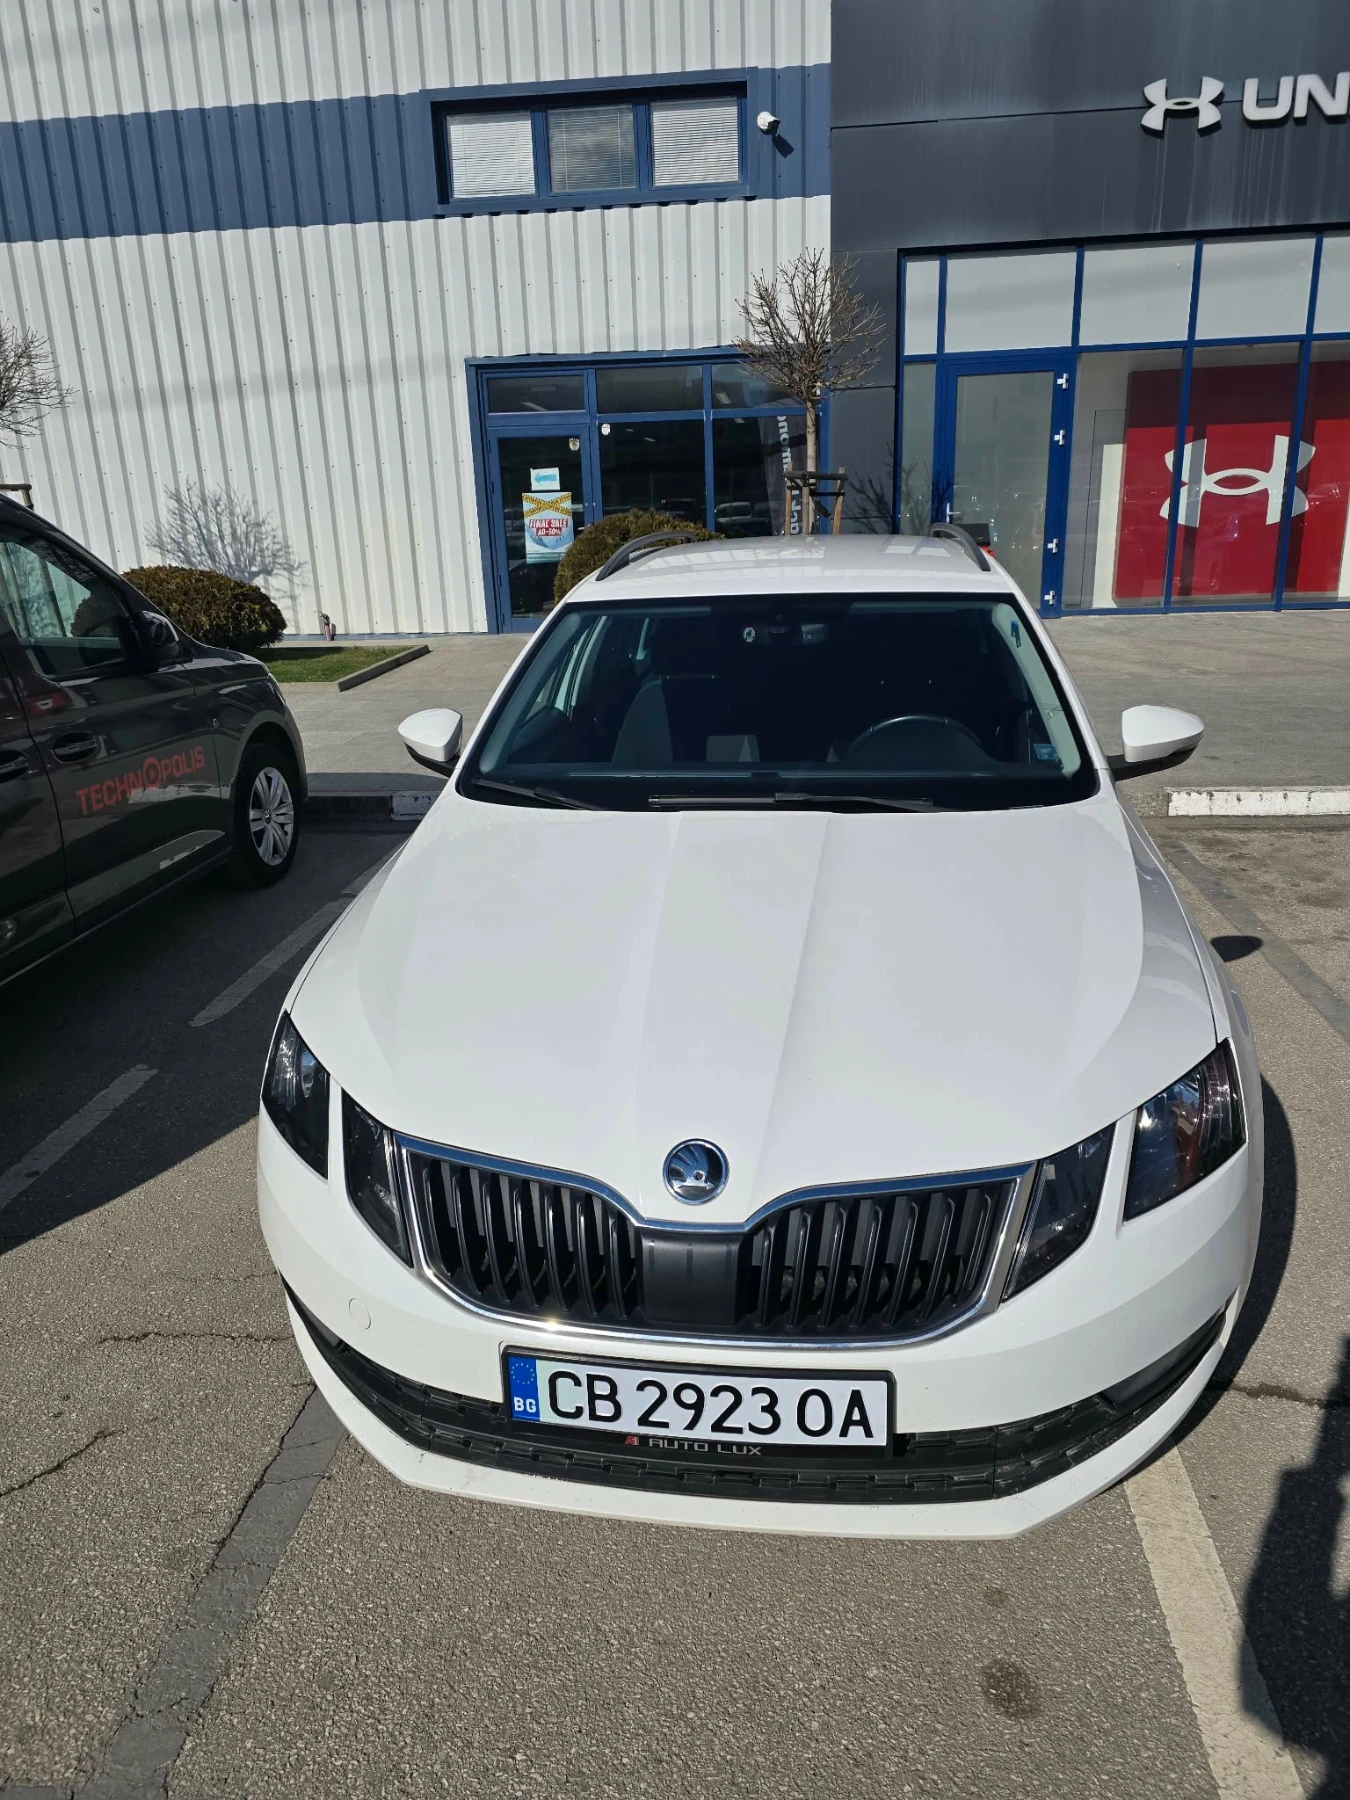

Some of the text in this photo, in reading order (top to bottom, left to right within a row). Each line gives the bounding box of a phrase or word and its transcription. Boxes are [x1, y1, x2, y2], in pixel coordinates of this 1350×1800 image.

[530, 518, 567, 528] FINAL SALE
[76, 746, 205, 816] TECHNOPOLIS
[513, 1396, 537, 1413] BG
[548, 1370, 622, 1423] CB
[636, 1379, 781, 1436] 2923
[648, 1438, 709, 1452] AUTO
[717, 1443, 762, 1456] LUX
